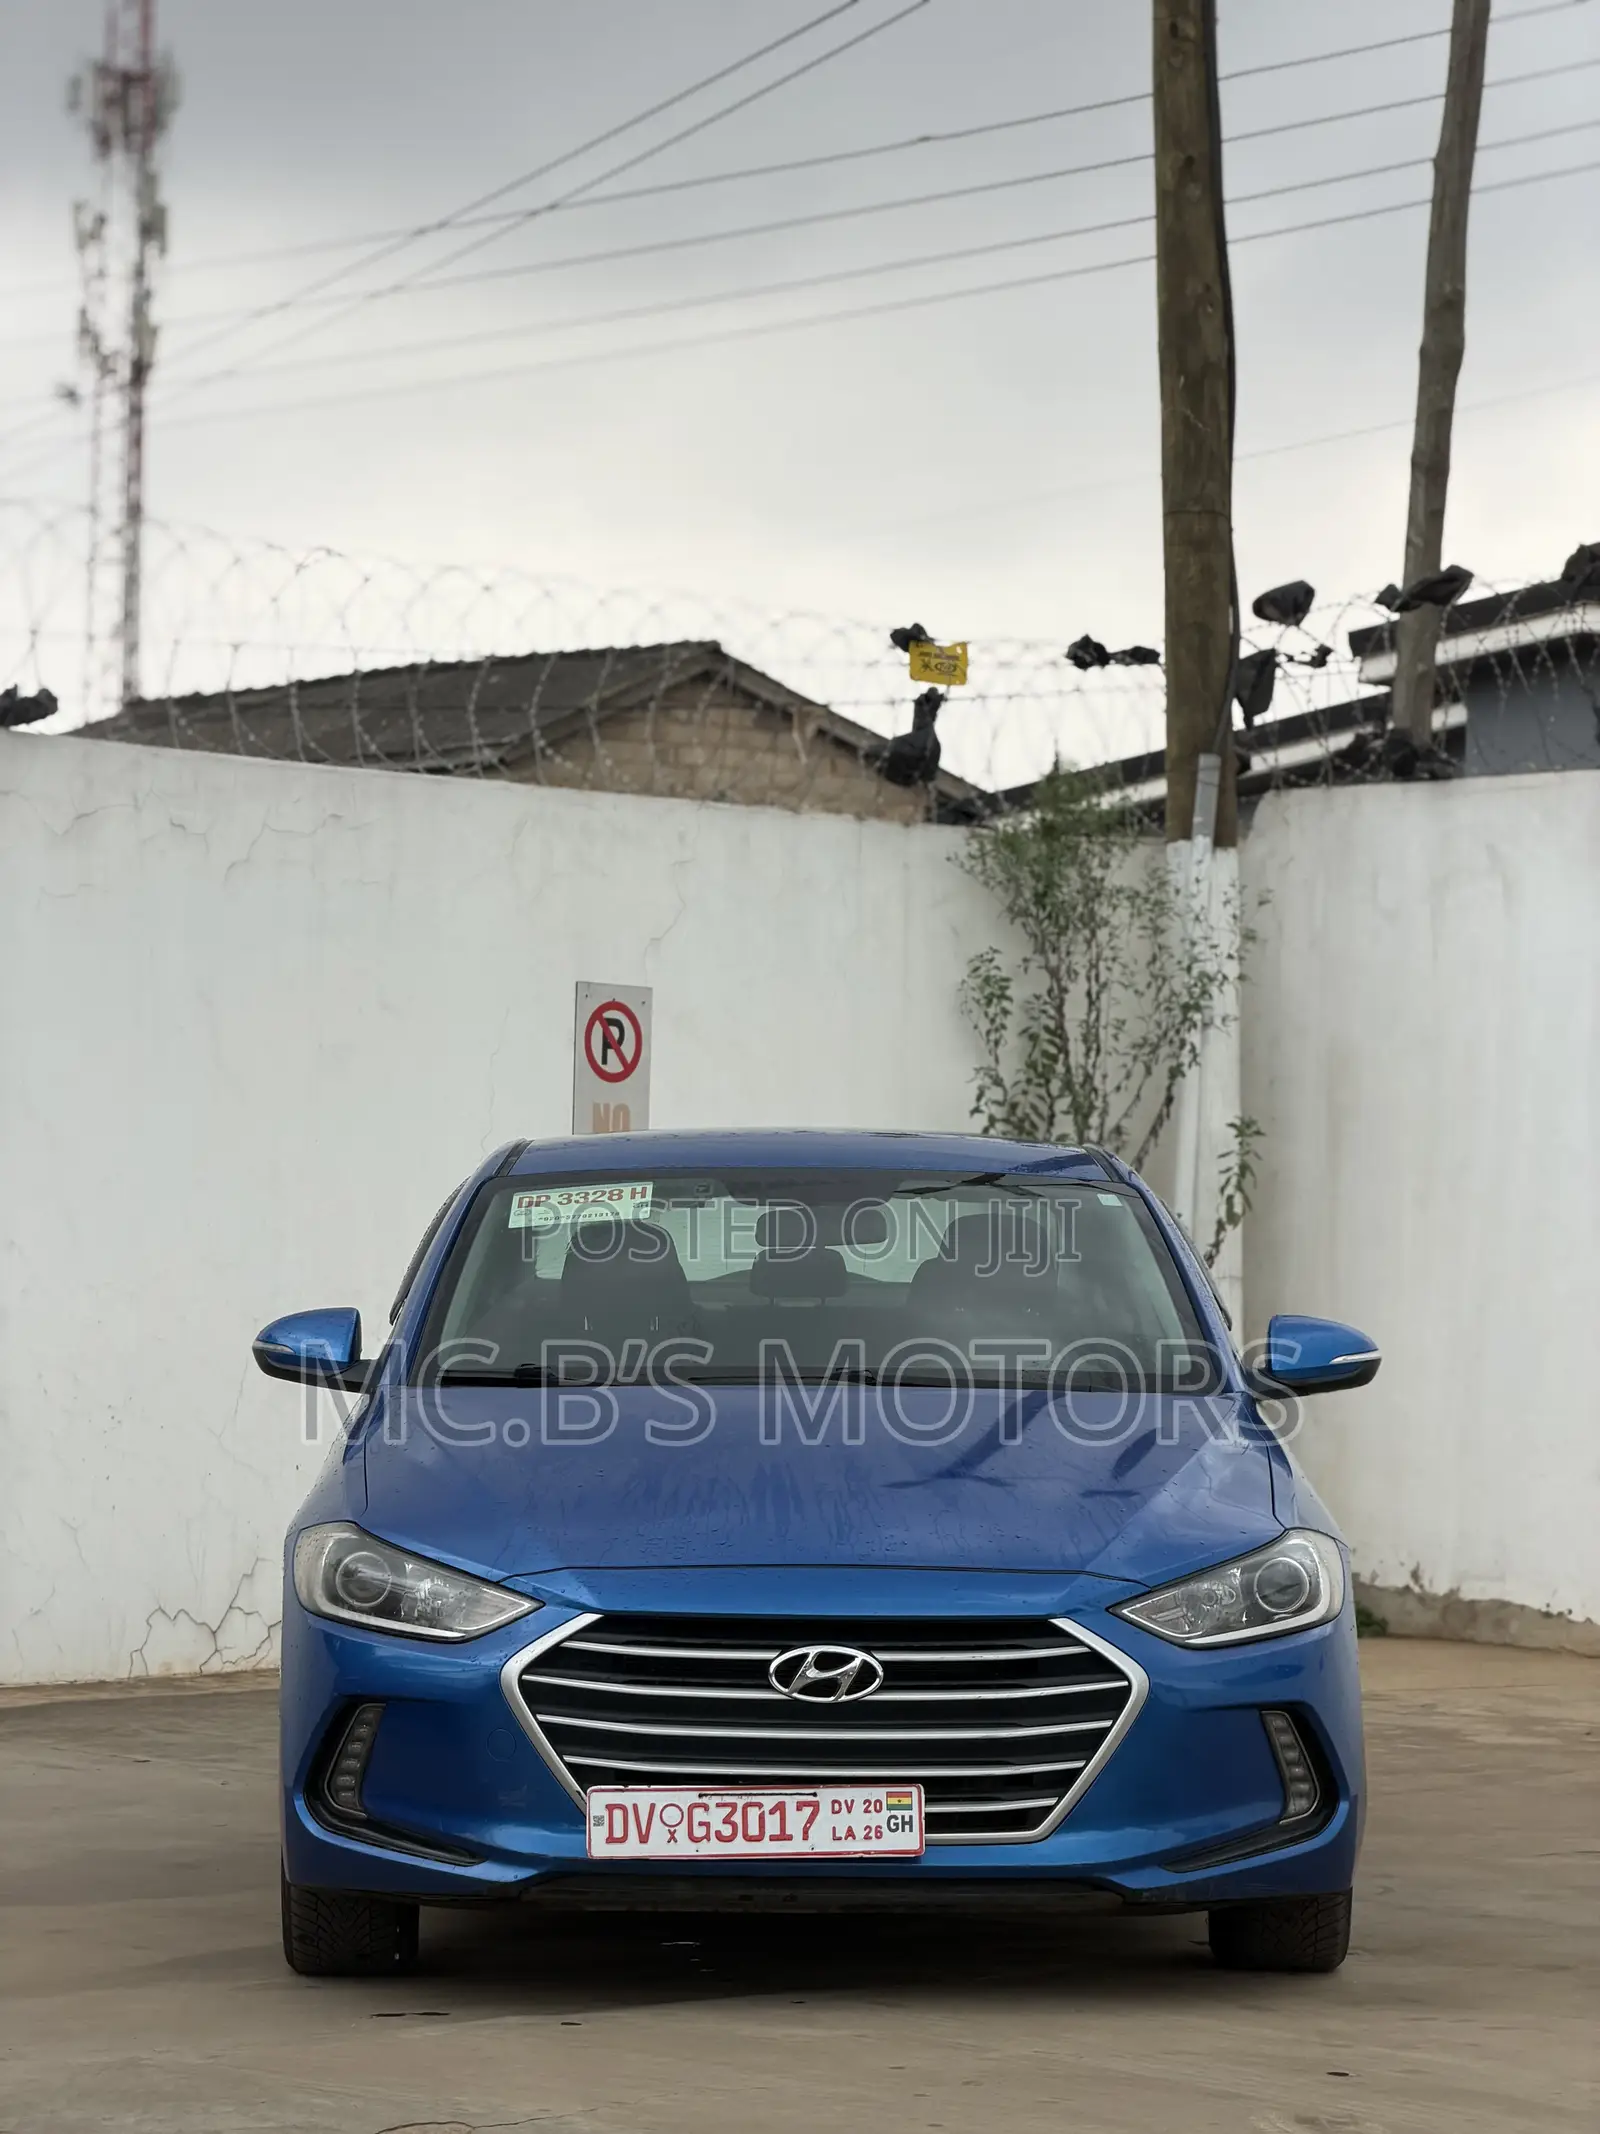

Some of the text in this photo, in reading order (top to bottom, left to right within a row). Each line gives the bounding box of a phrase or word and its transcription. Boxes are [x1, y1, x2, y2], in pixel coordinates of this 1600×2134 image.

[592, 1101, 631, 1133] NO
[517, 1186, 648, 1209] DP 3328 H
[830, 1798, 883, 1815] DV 20
[605, 1800, 820, 1844] DV G3017
[831, 1824, 883, 1841] LA 26
[886, 1814, 914, 1833] GH
